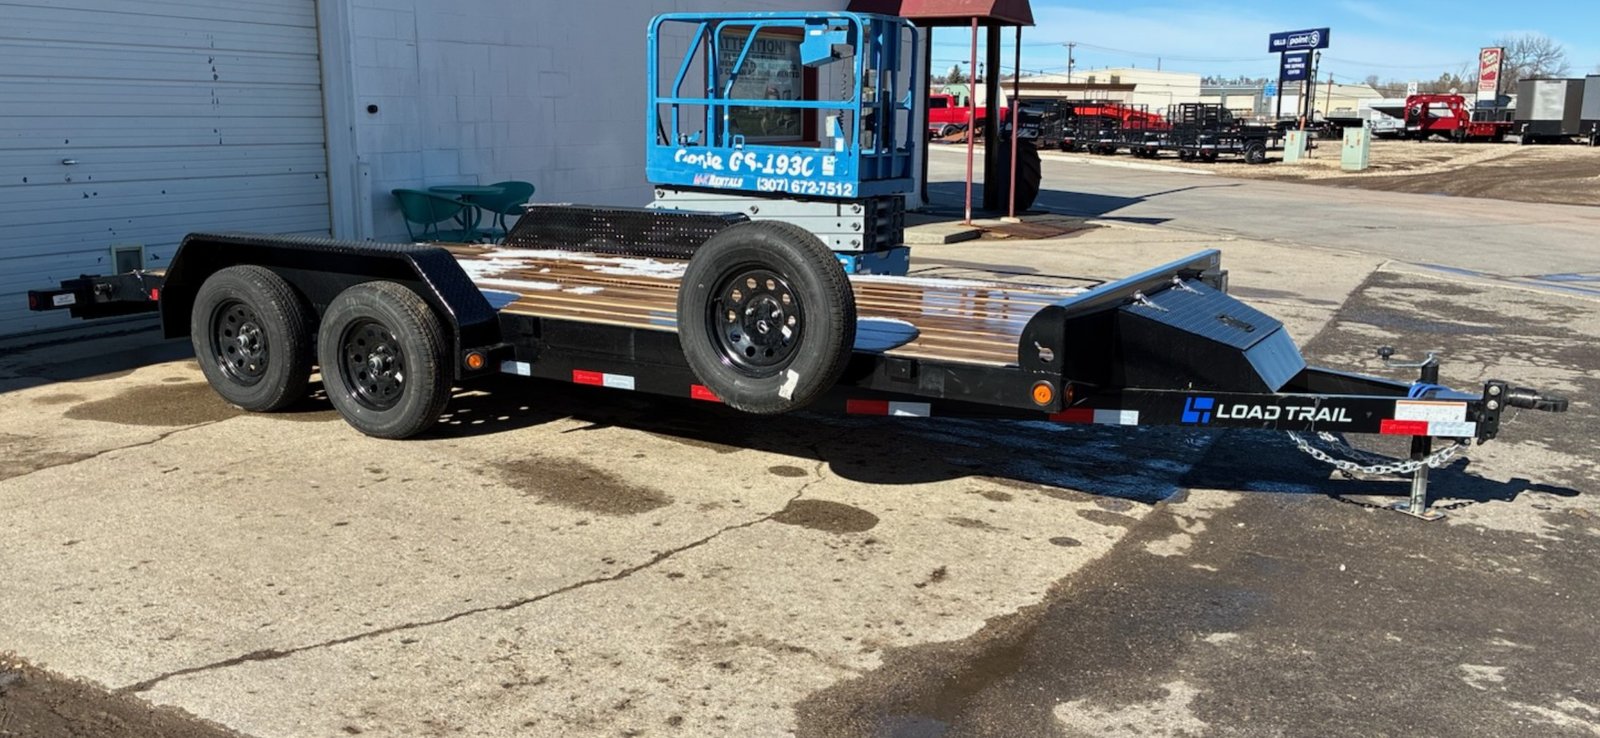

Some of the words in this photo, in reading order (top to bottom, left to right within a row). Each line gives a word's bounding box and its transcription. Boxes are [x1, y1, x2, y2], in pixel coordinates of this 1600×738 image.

[718, 37, 786, 53] ATTETION!
[1290, 36, 1308, 46] point
[757, 177, 788, 192] (307)
[791, 179, 853, 197] 672-7512
[1216, 403, 1281, 420] LOAD
[1285, 406, 1352, 422] TRAIL
